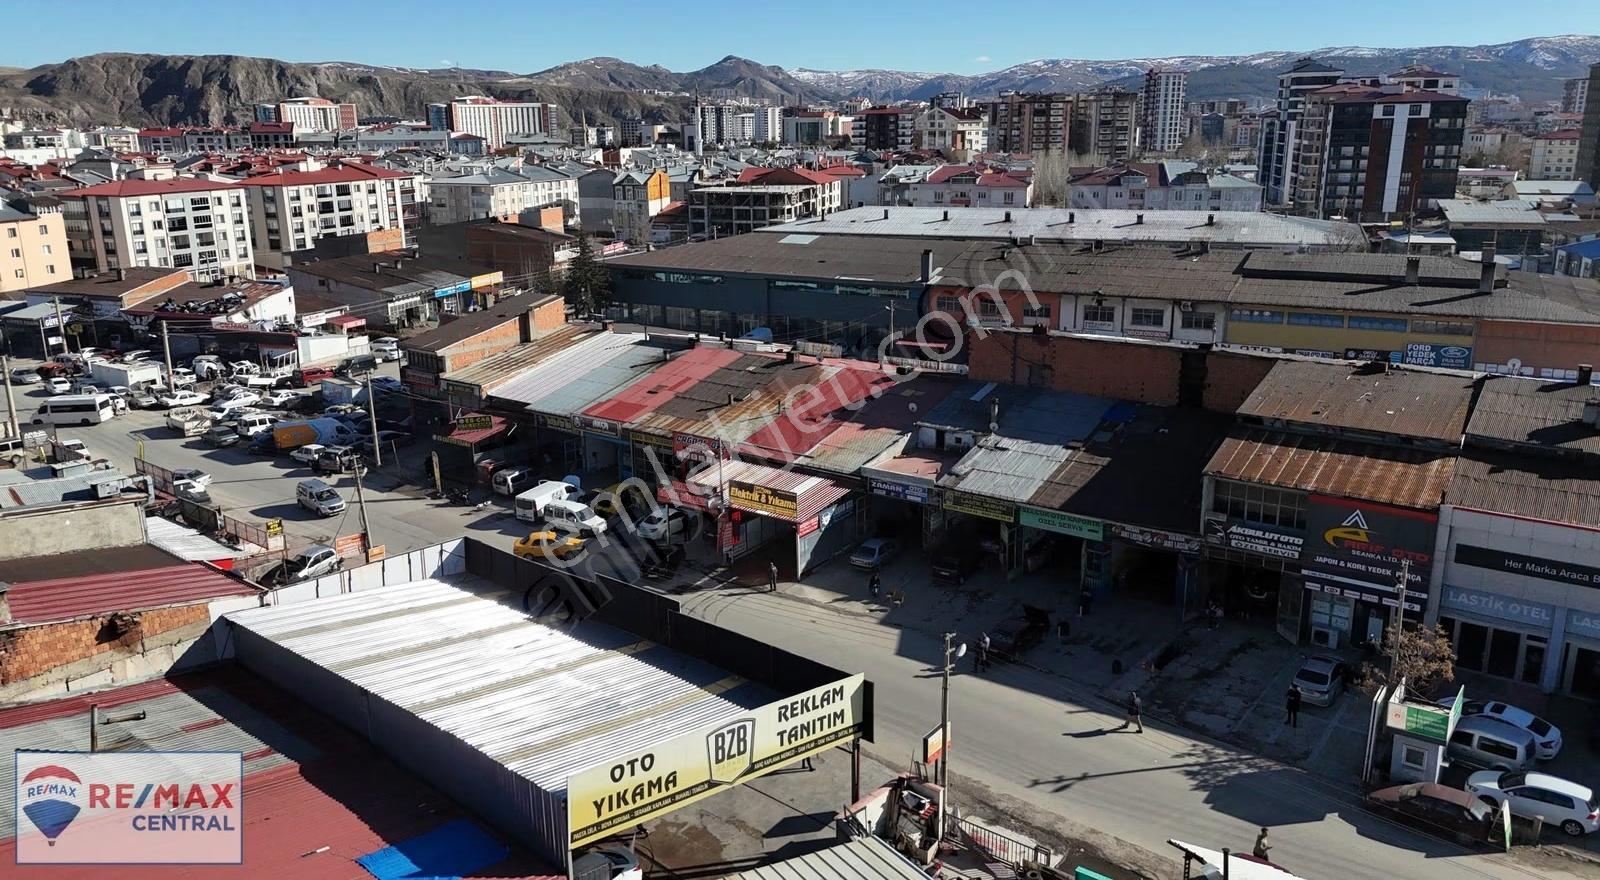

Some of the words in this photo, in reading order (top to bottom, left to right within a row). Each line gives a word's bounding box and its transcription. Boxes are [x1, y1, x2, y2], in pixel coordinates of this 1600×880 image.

[1406, 357, 1435, 366] PARÇA
[1407, 351, 1436, 359] YEDEK
[730, 486, 760, 502] Elektrik
[760, 494, 767, 504] &
[871, 481, 903, 492] ZAMAN
[908, 485, 923, 493] OTO
[1234, 541, 1258, 550] ÖZEL
[1262, 546, 1296, 558] SERVİS
[1246, 537, 1268, 546] TAMİR
[1277, 543, 1302, 552] BAKIM
[1391, 547, 1431, 562] OTO
[1313, 555, 1338, 566] JAPON
[1346, 562, 1366, 571] KORE
[1367, 565, 1392, 576] YEDEK
[1395, 569, 1422, 582] PRÇA
[1504, 559, 1522, 569] Her
[1525, 562, 1557, 575] Marka
[1558, 568, 1589, 582] Araca
[1448, 590, 1504, 611] LASTİK
[1508, 602, 1551, 621] OTEL
[778, 685, 844, 722] REKLAM
[776, 708, 845, 747] TANITIM
[714, 724, 747, 765] BZB
[609, 753, 655, 783] OTO
[592, 770, 678, 819] YIKAMA
[652, 798, 672, 811] KAPLAMA
